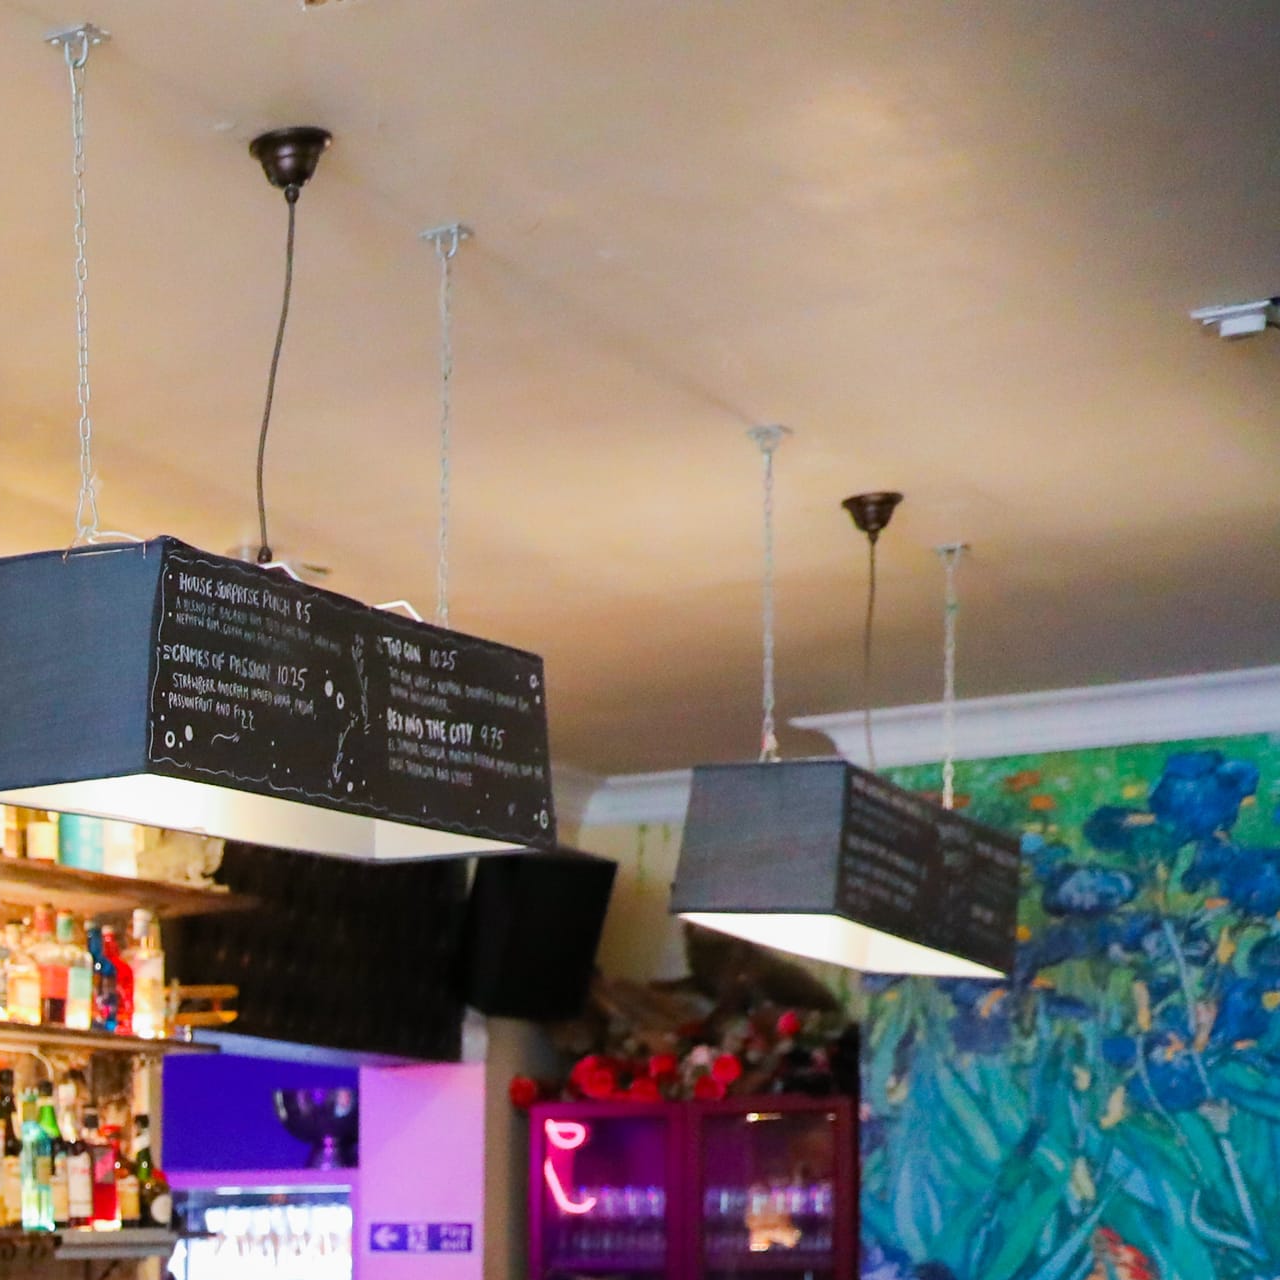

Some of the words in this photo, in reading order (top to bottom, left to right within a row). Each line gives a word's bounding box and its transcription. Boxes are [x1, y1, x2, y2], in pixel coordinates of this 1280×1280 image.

[179, 572, 212, 598] HOUSE
[263, 590, 290, 616] PUNCH
[172, 644, 210, 669] CRIMES
[211, 652, 225, 671] OF
[229, 655, 271, 681] PASSION
[383, 636, 401, 664] TOP
[404, 641, 421, 663] GUN
[216, 702, 230, 717] AND
[425, 719, 447, 742] THE
[449, 722, 474, 745] CITY
